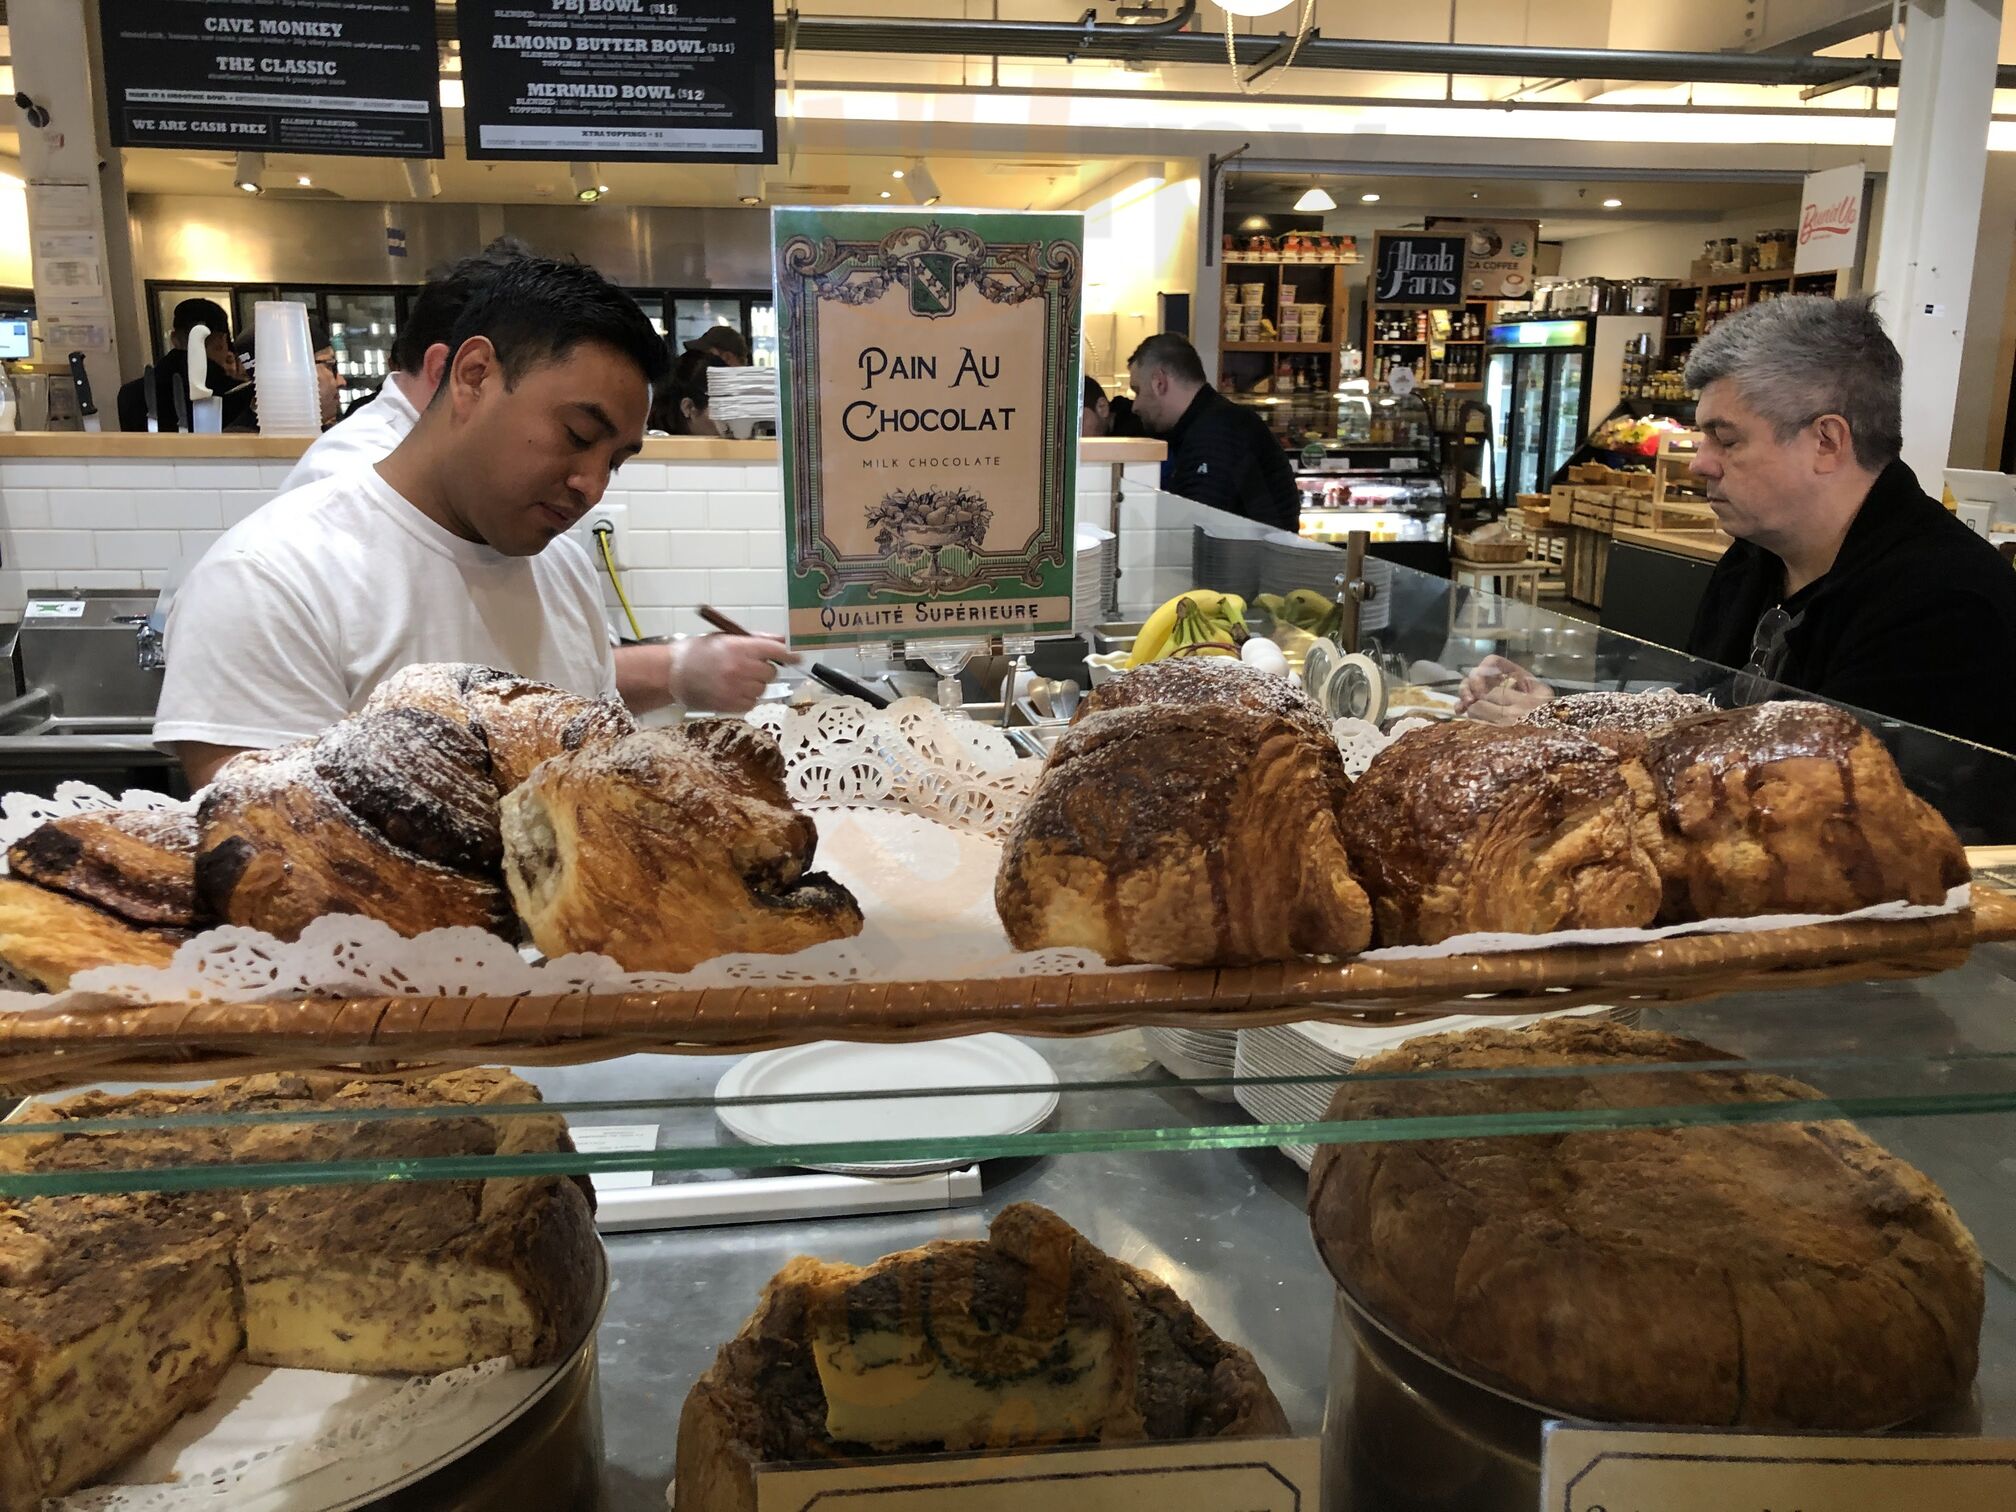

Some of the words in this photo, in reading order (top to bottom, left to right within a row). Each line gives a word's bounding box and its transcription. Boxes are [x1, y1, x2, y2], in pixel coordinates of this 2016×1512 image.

[552, 0, 585, 14] PBJ
[588, 0, 644, 12] BOWL
[204, 17, 255, 33] CAVE
[259, 19, 343, 37] MONKEY
[492, 35, 572, 50] ALMOND
[576, 37, 648, 52] BUTTER
[651, 39, 705, 53] BOWL
[216, 56, 255, 72] THE
[260, 58, 337, 75] CLASSIC
[527, 83, 618, 98] MERMAID
[621, 85, 675, 99] BOWL
[132, 119, 155, 130] WE
[158, 120, 187, 131] ARE
[190, 121, 227, 133] CASH
[230, 123, 267, 134] FREE
[1483, 261, 1520, 271] COFFEE
[842, 400, 1016, 442] CHOCOLAT
[862, 459, 899, 469] MILK
[909, 456, 1001, 468] CHOCOLATE
[820, 606, 904, 631] QUALITÉ
[915, 601, 1039, 623] SUPÉRIEURE
